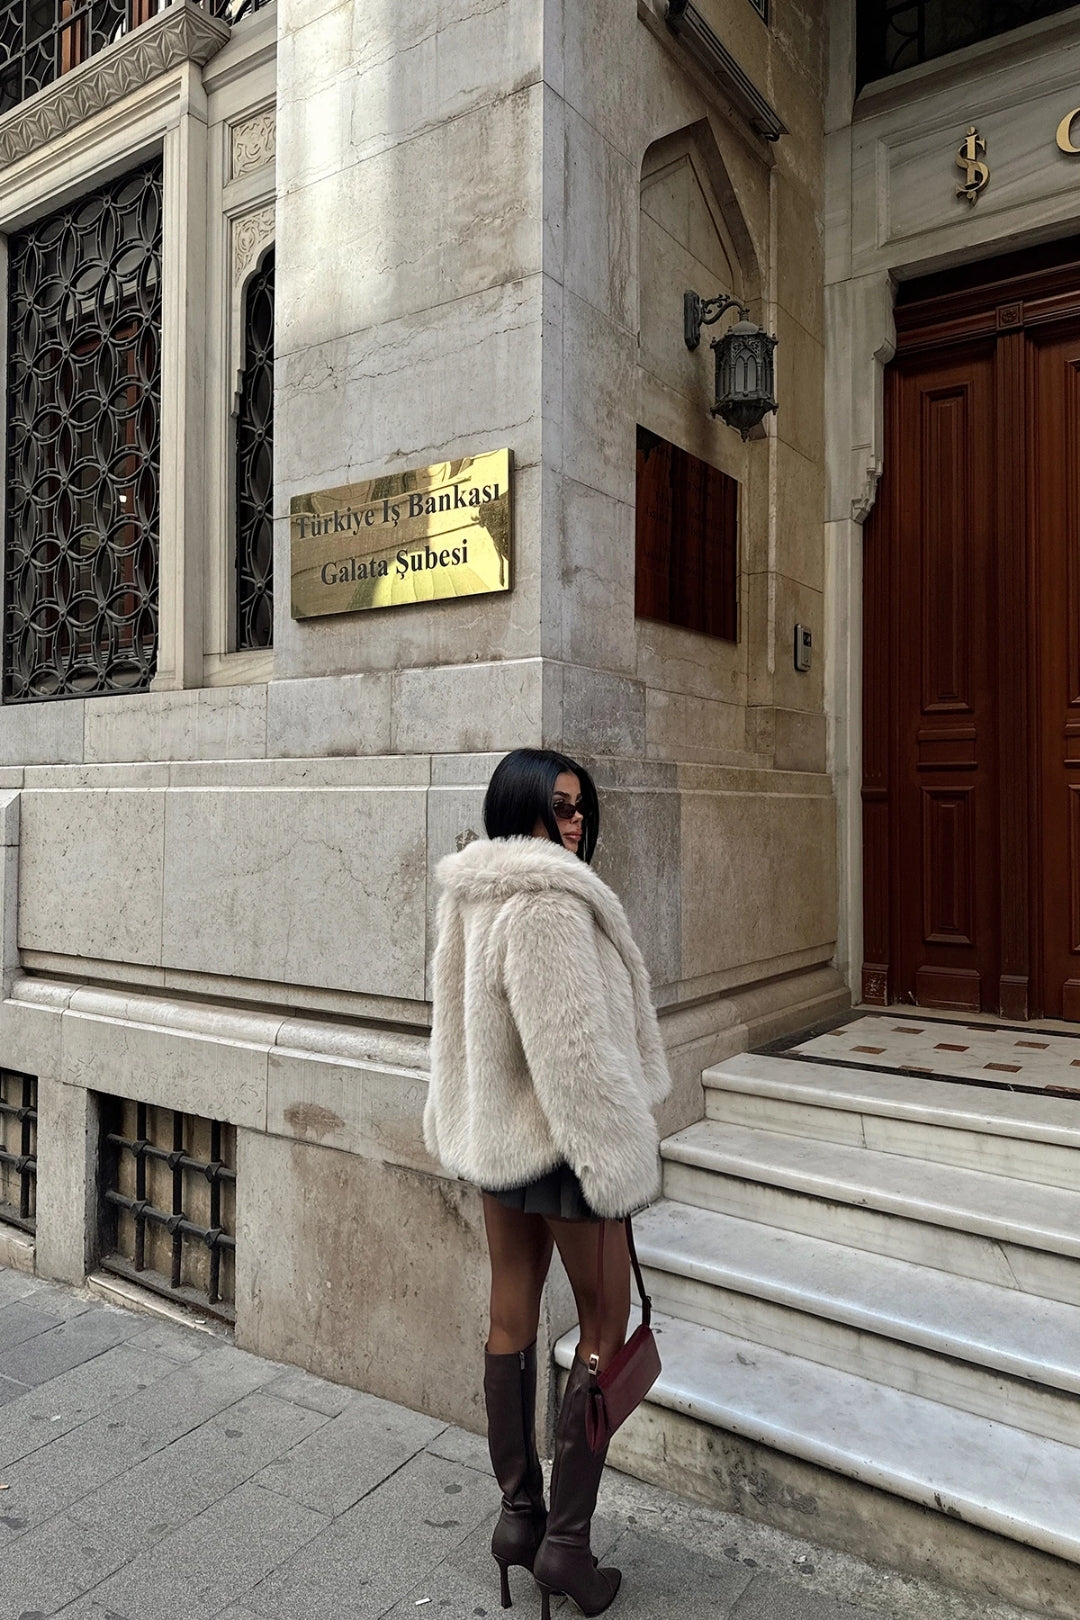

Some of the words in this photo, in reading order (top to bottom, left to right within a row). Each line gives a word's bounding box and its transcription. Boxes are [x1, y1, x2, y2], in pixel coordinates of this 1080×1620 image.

[296, 506, 375, 539] Türkiye
[408, 483, 500, 519] Bankası
[321, 557, 389, 586] Galata
[396, 539, 468, 580] Şubesi
